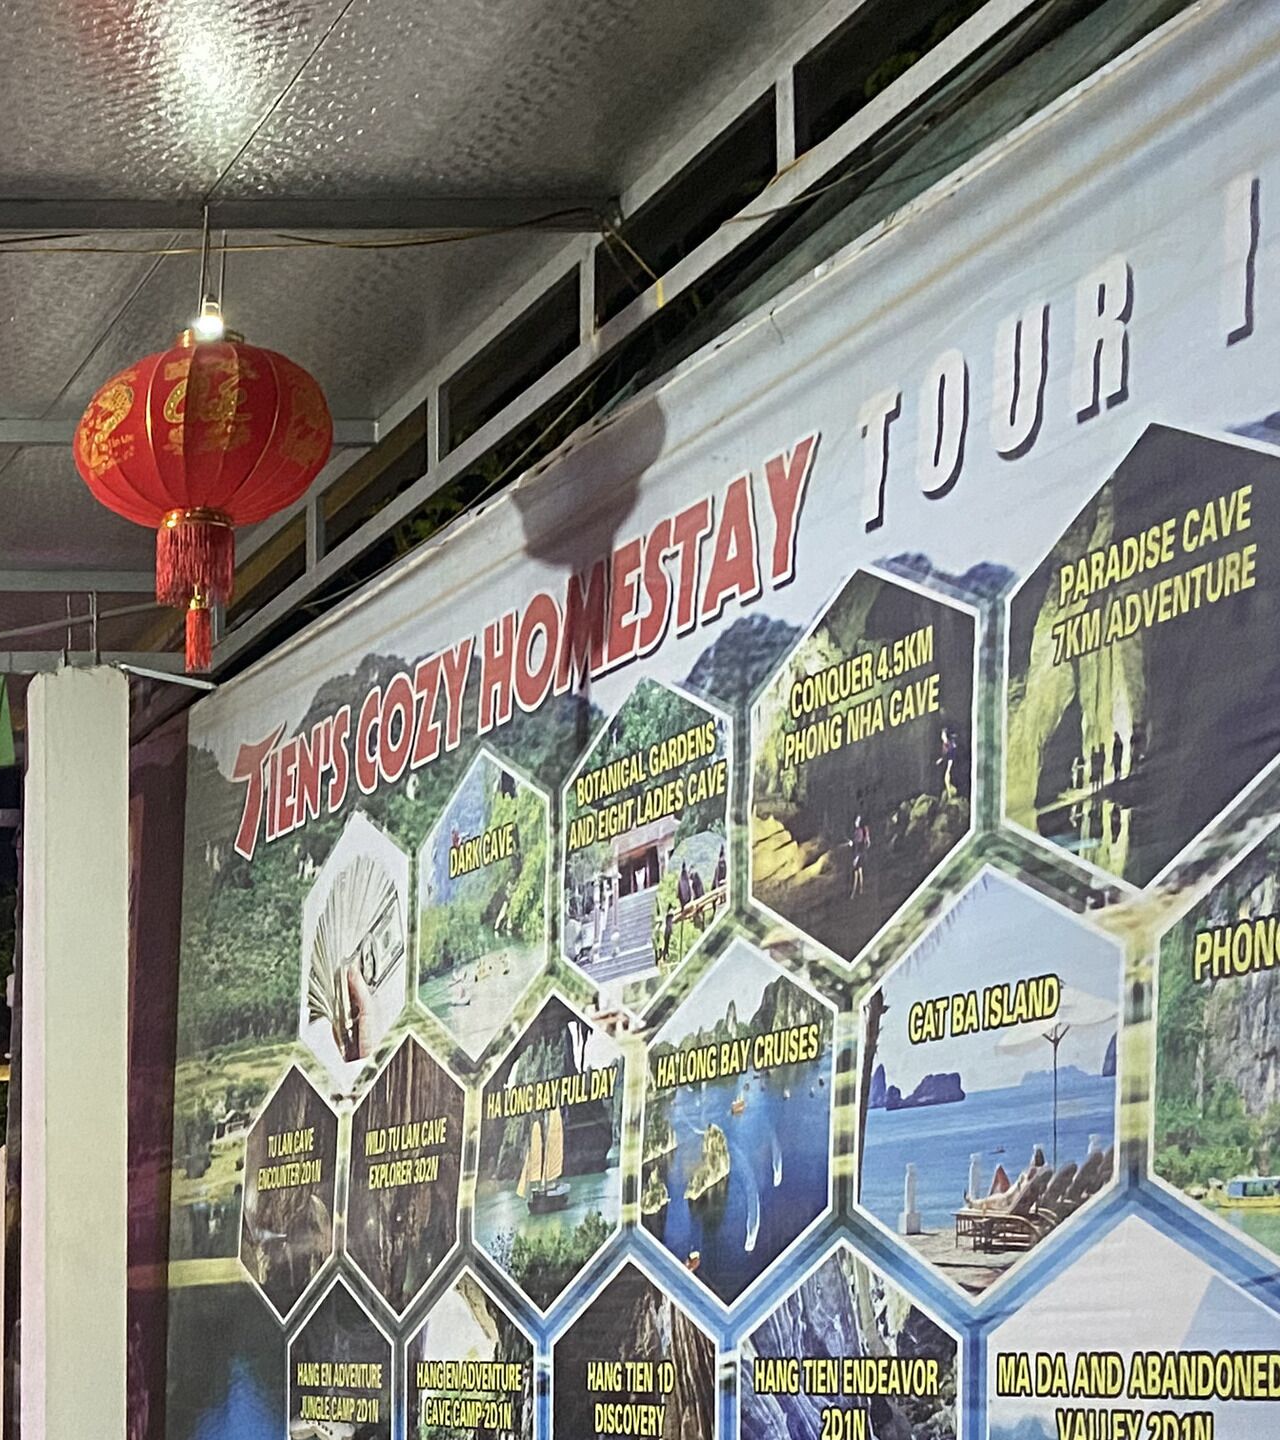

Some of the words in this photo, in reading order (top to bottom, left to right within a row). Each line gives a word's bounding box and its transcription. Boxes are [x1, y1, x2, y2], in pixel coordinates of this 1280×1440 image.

[232, 705, 351, 860] TIEN'S
[355, 636, 474, 795] COZY
[478, 431, 820, 734] HOMESTAY
[857, 253, 1133, 534] TOUR
[1059, 519, 1176, 606] PARADISE
[1183, 485, 1254, 553] CAVE
[1051, 612, 1102, 665] 7KM
[1106, 544, 1257, 646] ADVENTURE
[791, 653, 873, 719] CONQUER
[876, 625, 933, 684] 4.5KM
[783, 720, 843, 769] PHONG
[846, 702, 884, 746] NHA
[889, 674, 940, 726] CAVE
[576, 751, 646, 808] BOTANICAL
[649, 720, 716, 774] GARDENS
[569, 820, 595, 851] AND
[598, 800, 634, 841] EIGHT
[637, 780, 684, 826] LADIES
[687, 759, 727, 807] CAVE
[450, 835, 481, 878] DARK
[483, 823, 514, 868] CAVE
[909, 997, 948, 1044] CAT
[951, 991, 980, 1034] BA
[982, 974, 1061, 1030] ISLAND
[657, 1057, 676, 1088] HA
[678, 1045, 717, 1083] LONG
[720, 1039, 750, 1076] BAY
[754, 1024, 819, 1069] CRUISES
[487, 1092, 502, 1119] HA
[504, 1084, 533, 1117] LONG
[535, 1078, 559, 1111] BAY
[560, 1073, 588, 1106] FULL
[590, 1066, 618, 1100] DAY
[294, 1127, 314, 1153] CAVE
[365, 1130, 386, 1156] WILD
[388, 1127, 400, 1152] TU
[401, 1123, 420, 1150] LAN
[421, 1118, 447, 1145] CAVE
[258, 1162, 299, 1191] ENCOUNTER
[301, 1159, 322, 1185] 2D1N
[369, 1161, 412, 1190] EXPLORER
[414, 1156, 438, 1185] 3D2N
[297, 1362, 320, 1387] HANG
[321, 1363, 332, 1387] EN
[333, 1363, 382, 1389] ADVENTURE
[416, 1362, 444, 1390] HANG
[445, 1362, 460, 1391] EN
[461, 1361, 522, 1392] ADVENTURE
[587, 1361, 621, 1392] HANG
[624, 1362, 653, 1392] TIEN
[656, 1362, 674, 1393] 1D
[754, 1358, 799, 1394] HANG
[803, 1358, 838, 1394] TIEN
[844, 1358, 938, 1395] ENDEAVOR
[998, 1355, 1033, 1394] MA
[1037, 1356, 1071, 1395] DA
[1074, 1355, 1125, 1396] AND
[1129, 1354, 1280, 1398] ABANDONED
[300, 1397, 330, 1421] JUNGLE
[331, 1397, 355, 1423] CAMP
[356, 1398, 379, 1423] 2D1N
[425, 1397, 451, 1426] CAVE
[452, 1397, 482, 1428] CAMP
[483, 1398, 512, 1430] 2D1N
[595, 1405, 665, 1438] DISCOVERY
